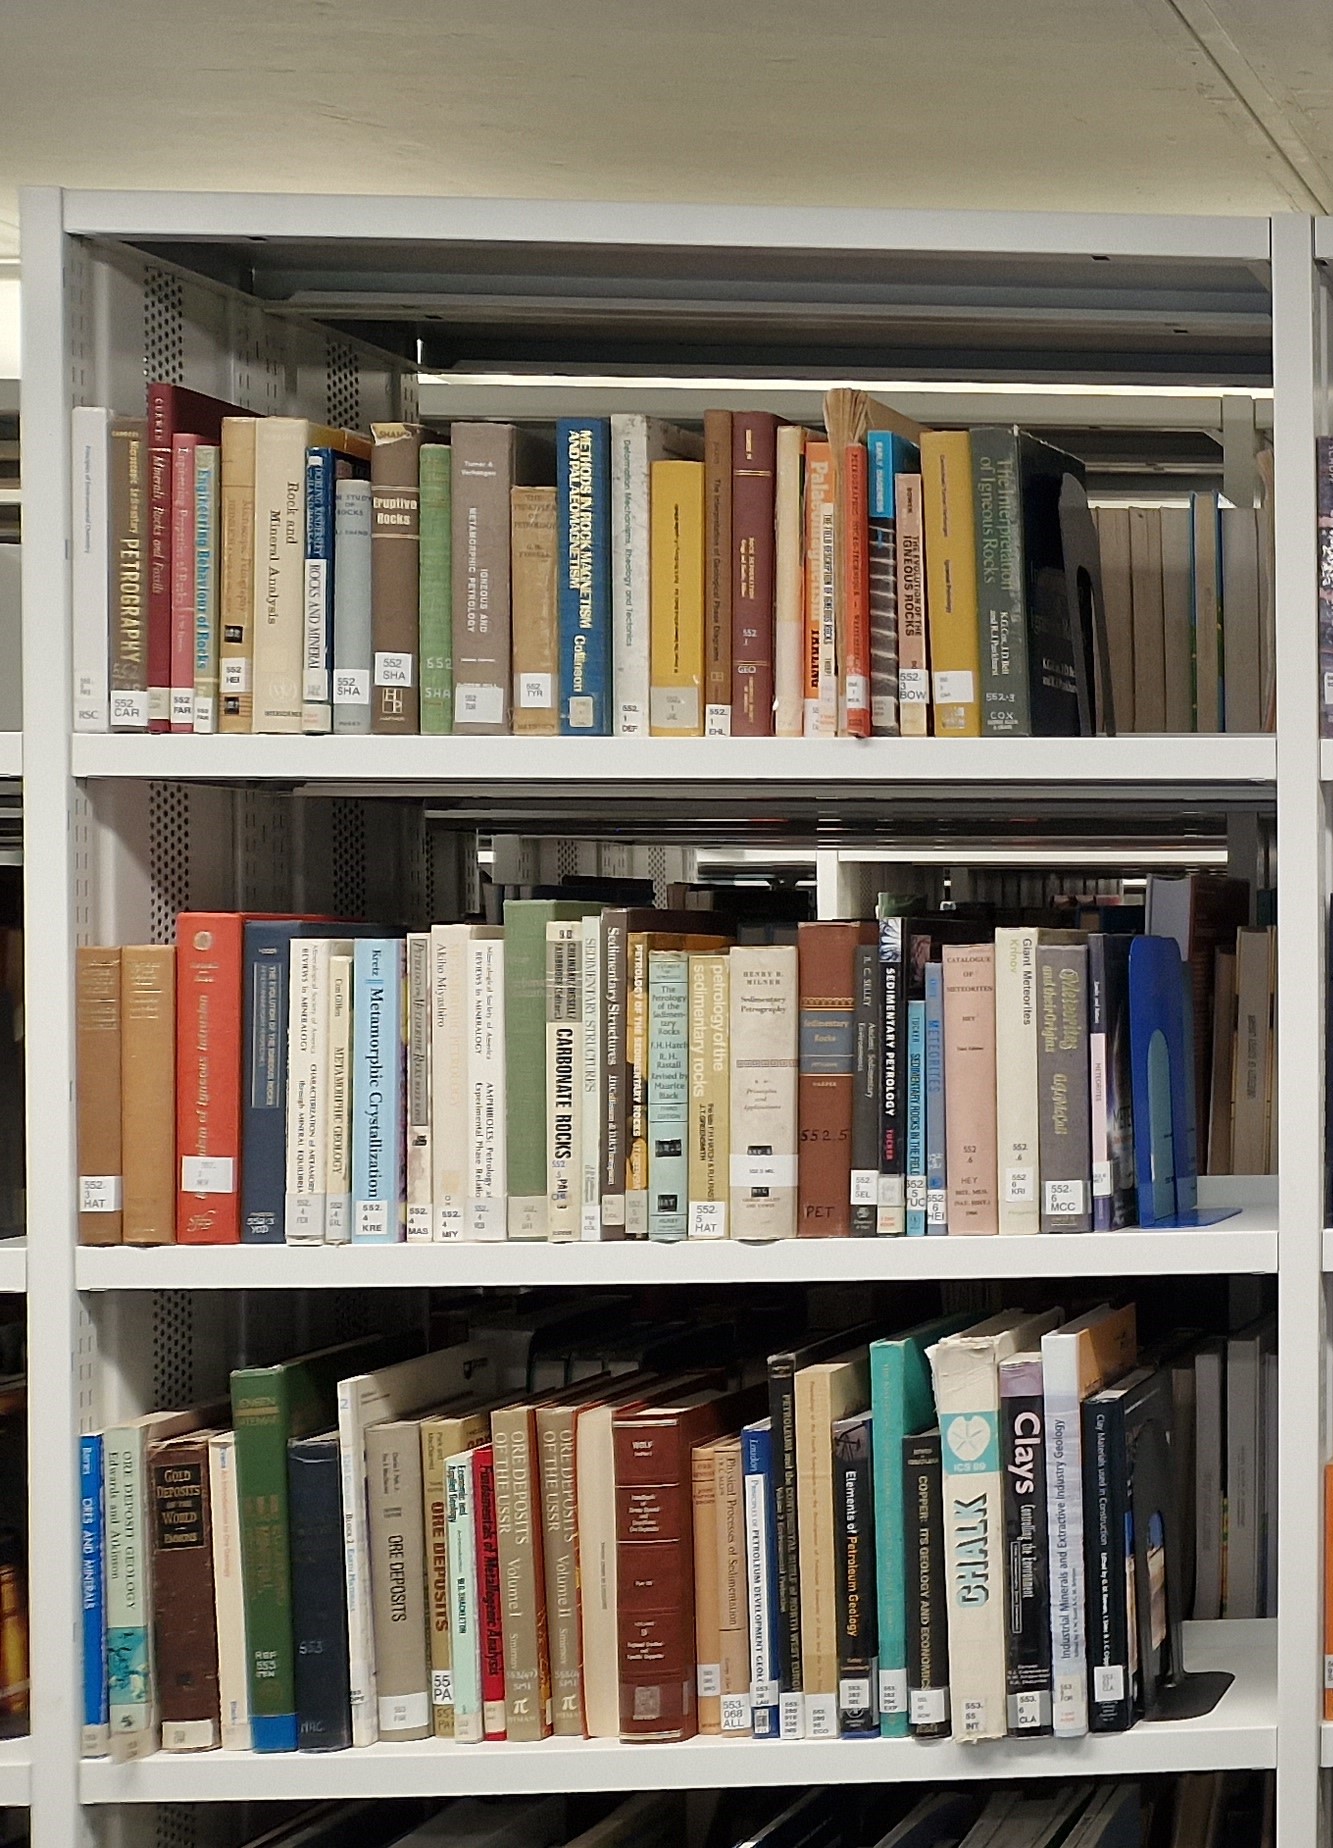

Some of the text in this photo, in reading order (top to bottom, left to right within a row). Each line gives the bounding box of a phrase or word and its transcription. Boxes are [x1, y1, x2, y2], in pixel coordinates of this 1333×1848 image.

[152, 507, 164, 535] Rocks
[286, 481, 299, 544] Rock and
[373, 498, 417, 509] Eruptive
[377, 513, 410, 524] Rocks
[569, 431, 580, 589] AND PALAEOMAGNETISM
[580, 431, 592, 628] METHODS IN ROCK MAGNETISM
[152, 539, 163, 558] and
[267, 510, 280, 625] Mineral Analysis
[308, 564, 321, 598] ROCKS
[120, 539, 140, 662] PETROGRAPHY
[308, 602, 321, 624] AND
[114, 700, 132, 708] 552
[383, 658, 402, 667] 552
[383, 671, 406, 680] SHA
[574, 635, 585, 692] Collinson
[114, 708, 140, 716] CAR
[606, 928, 619, 1066] Sedimentary Structures
[709, 964, 727, 1071] petrology of the
[885, 968, 896, 1048] SEDIMENTARY
[1022, 938, 1033, 1026] Giant Meteorites
[690, 964, 708, 1097] sedimentary rocks
[365, 949, 384, 1198] Kretz Metamorphic Crystallization
[555, 1028, 573, 1160] CARBONATE ROCKS
[884, 1052, 896, 1116] PETROLOGY
[512, 1431, 528, 1545] ORE DEPOSITS
[1007, 1411, 1040, 1494] Clays
[82, 1498, 95, 1609] ORES AND MINERALS
[123, 1451, 136, 1610] ORE DEPOSIT GEOLOGY
[844, 1471, 860, 1636] Elements of Petroleum Geology
[953, 1494, 989, 1608] CHALK
[388, 1535, 406, 1622] ORE DEPOSITS
[506, 1558, 521, 1607] Volume
